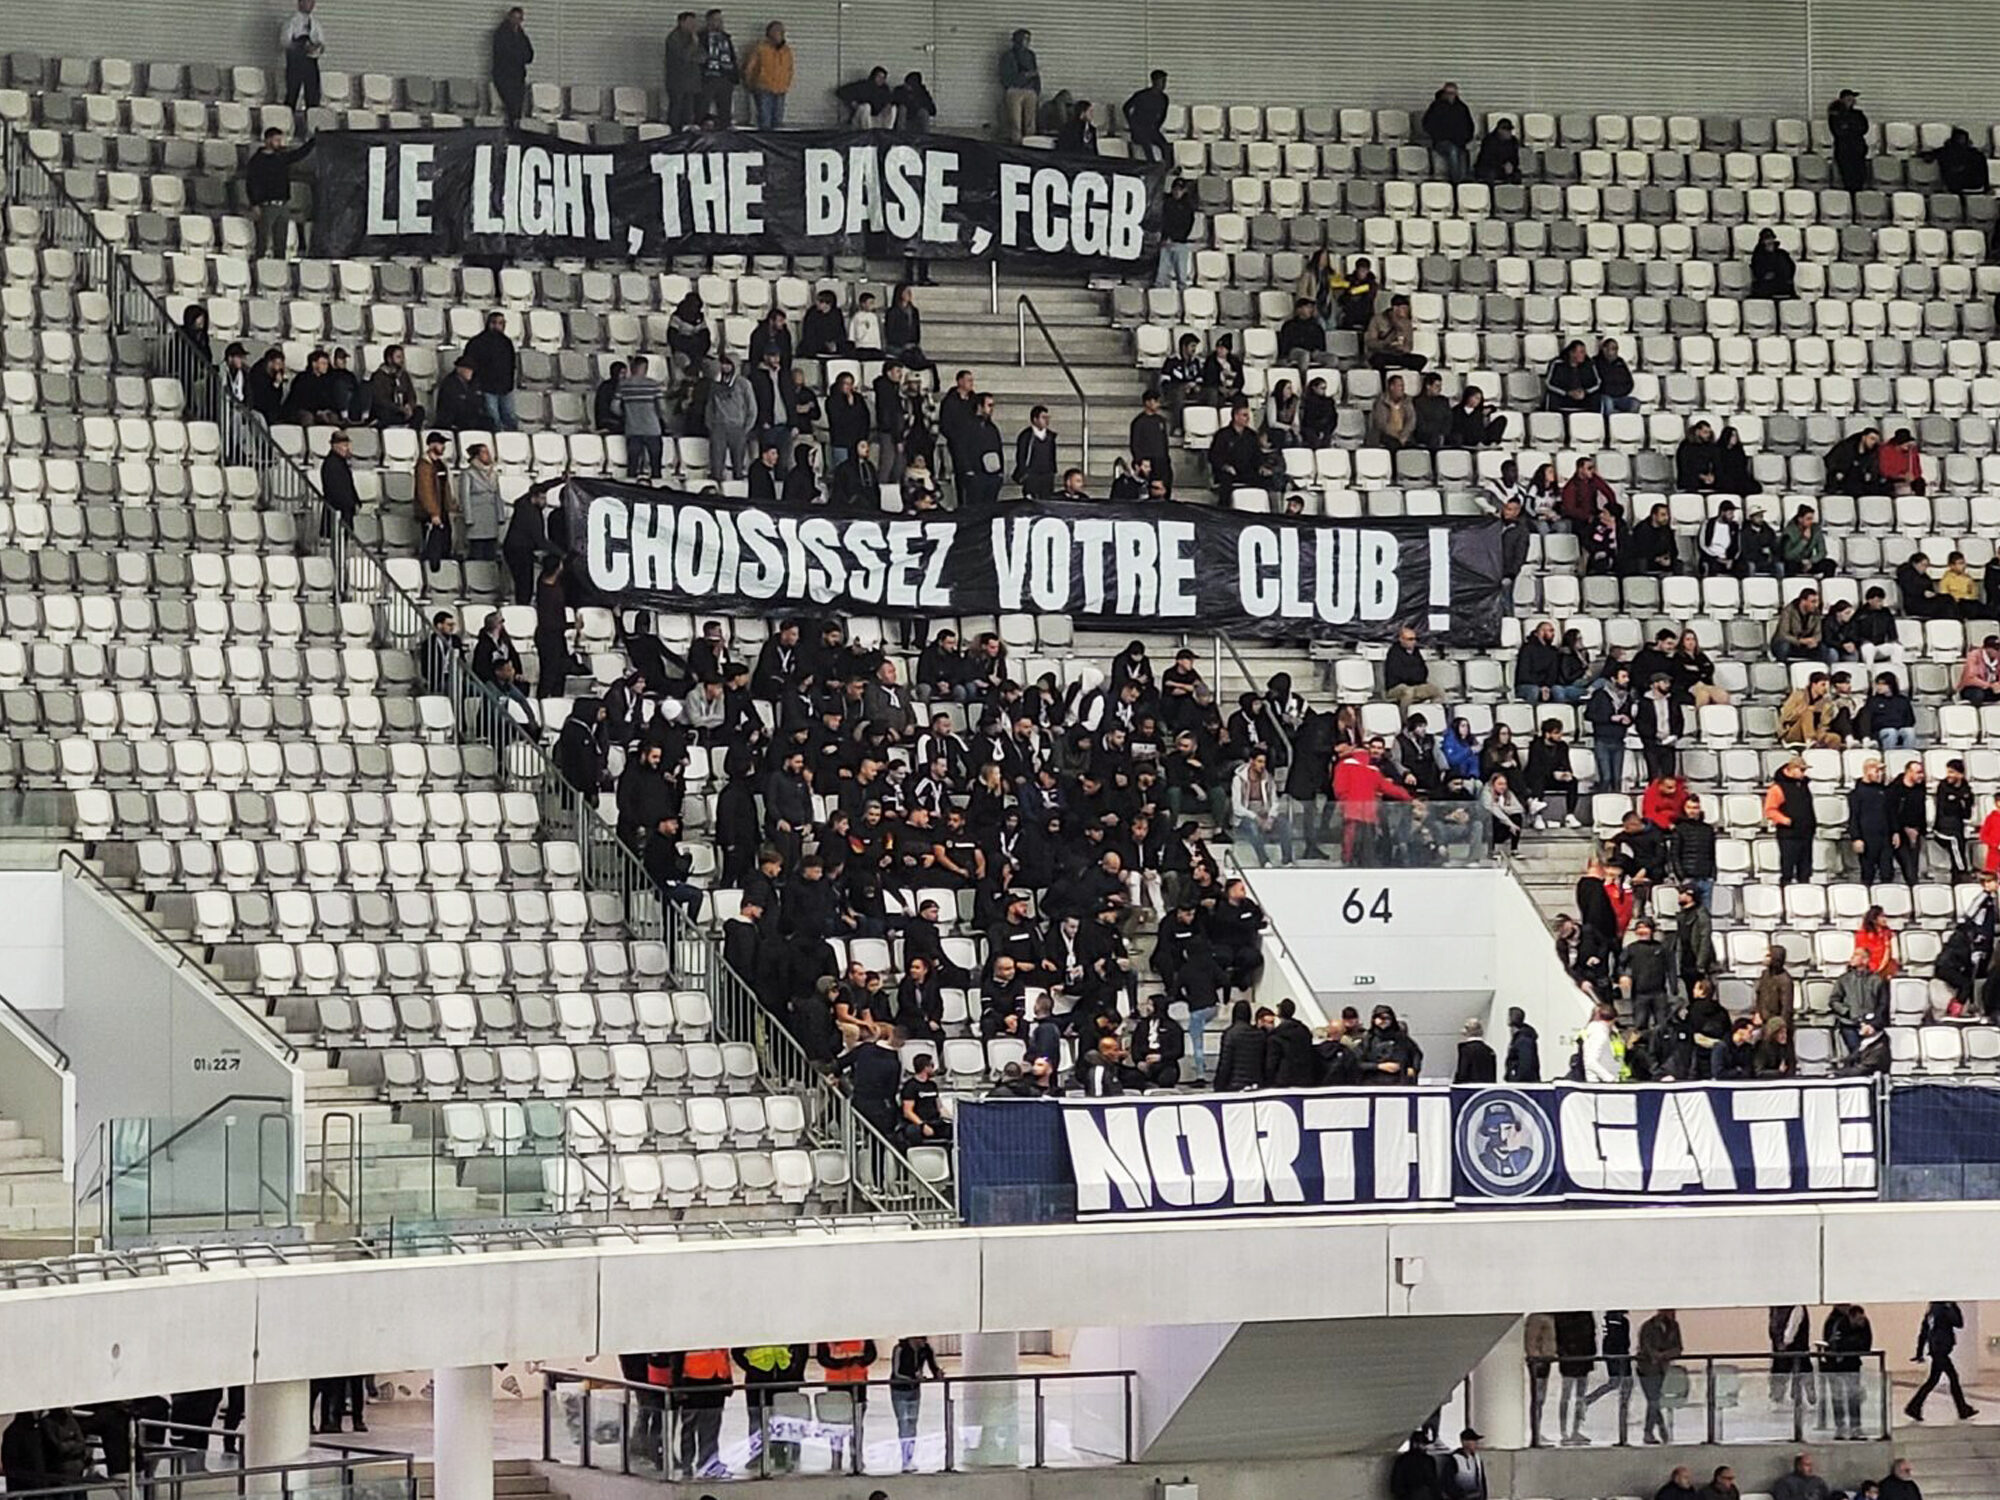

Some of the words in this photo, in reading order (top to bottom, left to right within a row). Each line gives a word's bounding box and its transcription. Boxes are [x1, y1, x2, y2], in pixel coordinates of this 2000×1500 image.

[366, 143, 434, 235] LE
[650, 151, 765, 238] THE
[1000, 162, 1147, 260] FCGB
[587, 496, 957, 607] CHOISISSEZ
[991, 517, 1197, 617] VOTRE
[1237, 525, 1400, 624] CLUB
[1342, 887, 1393, 924] 64
[1063, 1096, 1452, 1211] NORTH
[1559, 1086, 1876, 1192] GATE
